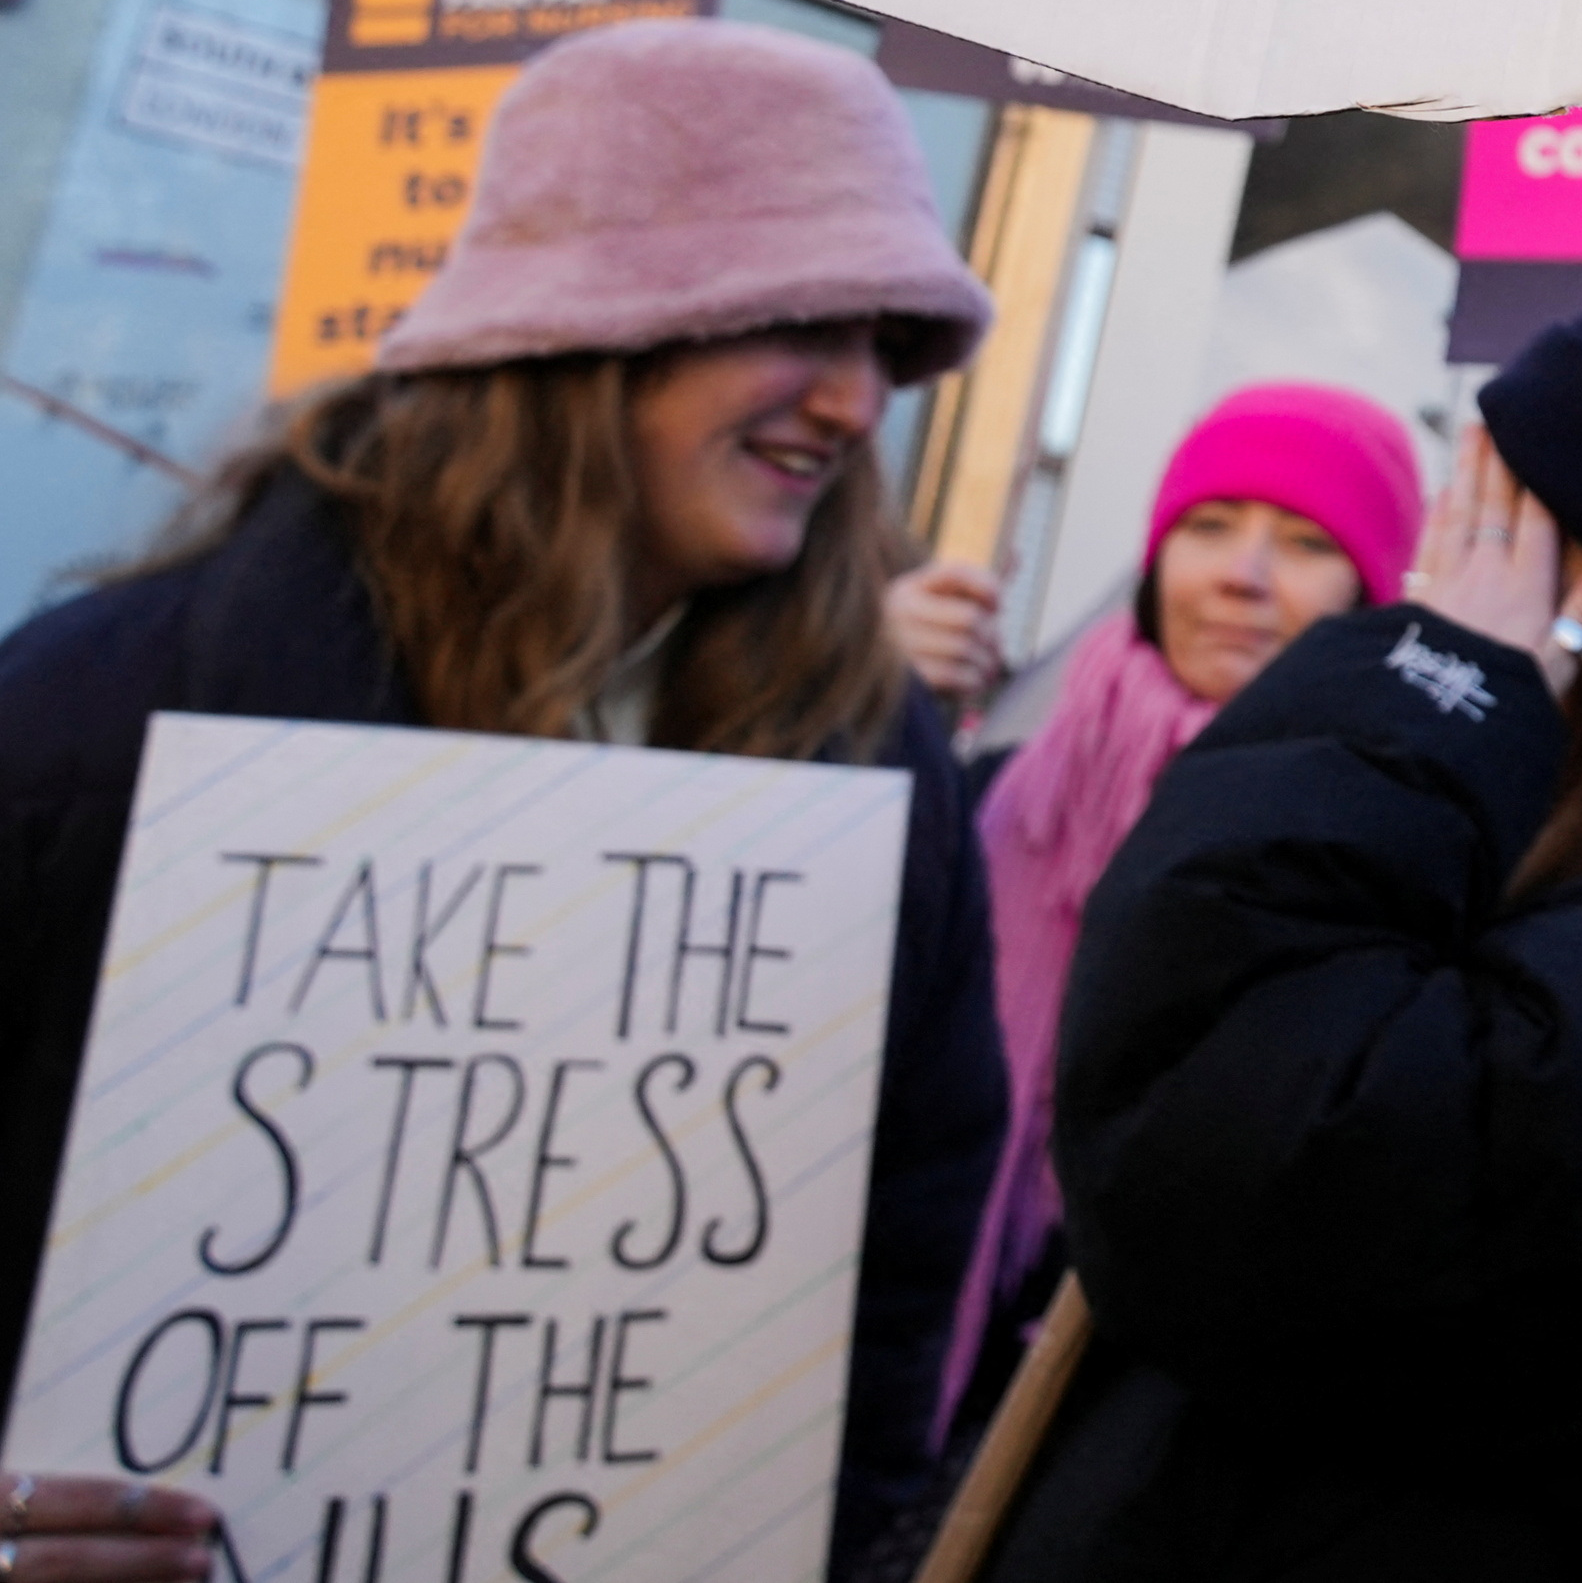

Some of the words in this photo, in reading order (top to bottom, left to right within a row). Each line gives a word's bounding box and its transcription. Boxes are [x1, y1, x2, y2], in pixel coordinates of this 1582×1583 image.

[403, 174, 467, 208] to
[217, 851, 545, 1028] TAKE
[602, 852, 807, 1041] THE
[198, 1041, 781, 1278] STRESS
[113, 1307, 366, 1475] OFF
[455, 1310, 668, 1473] THE
